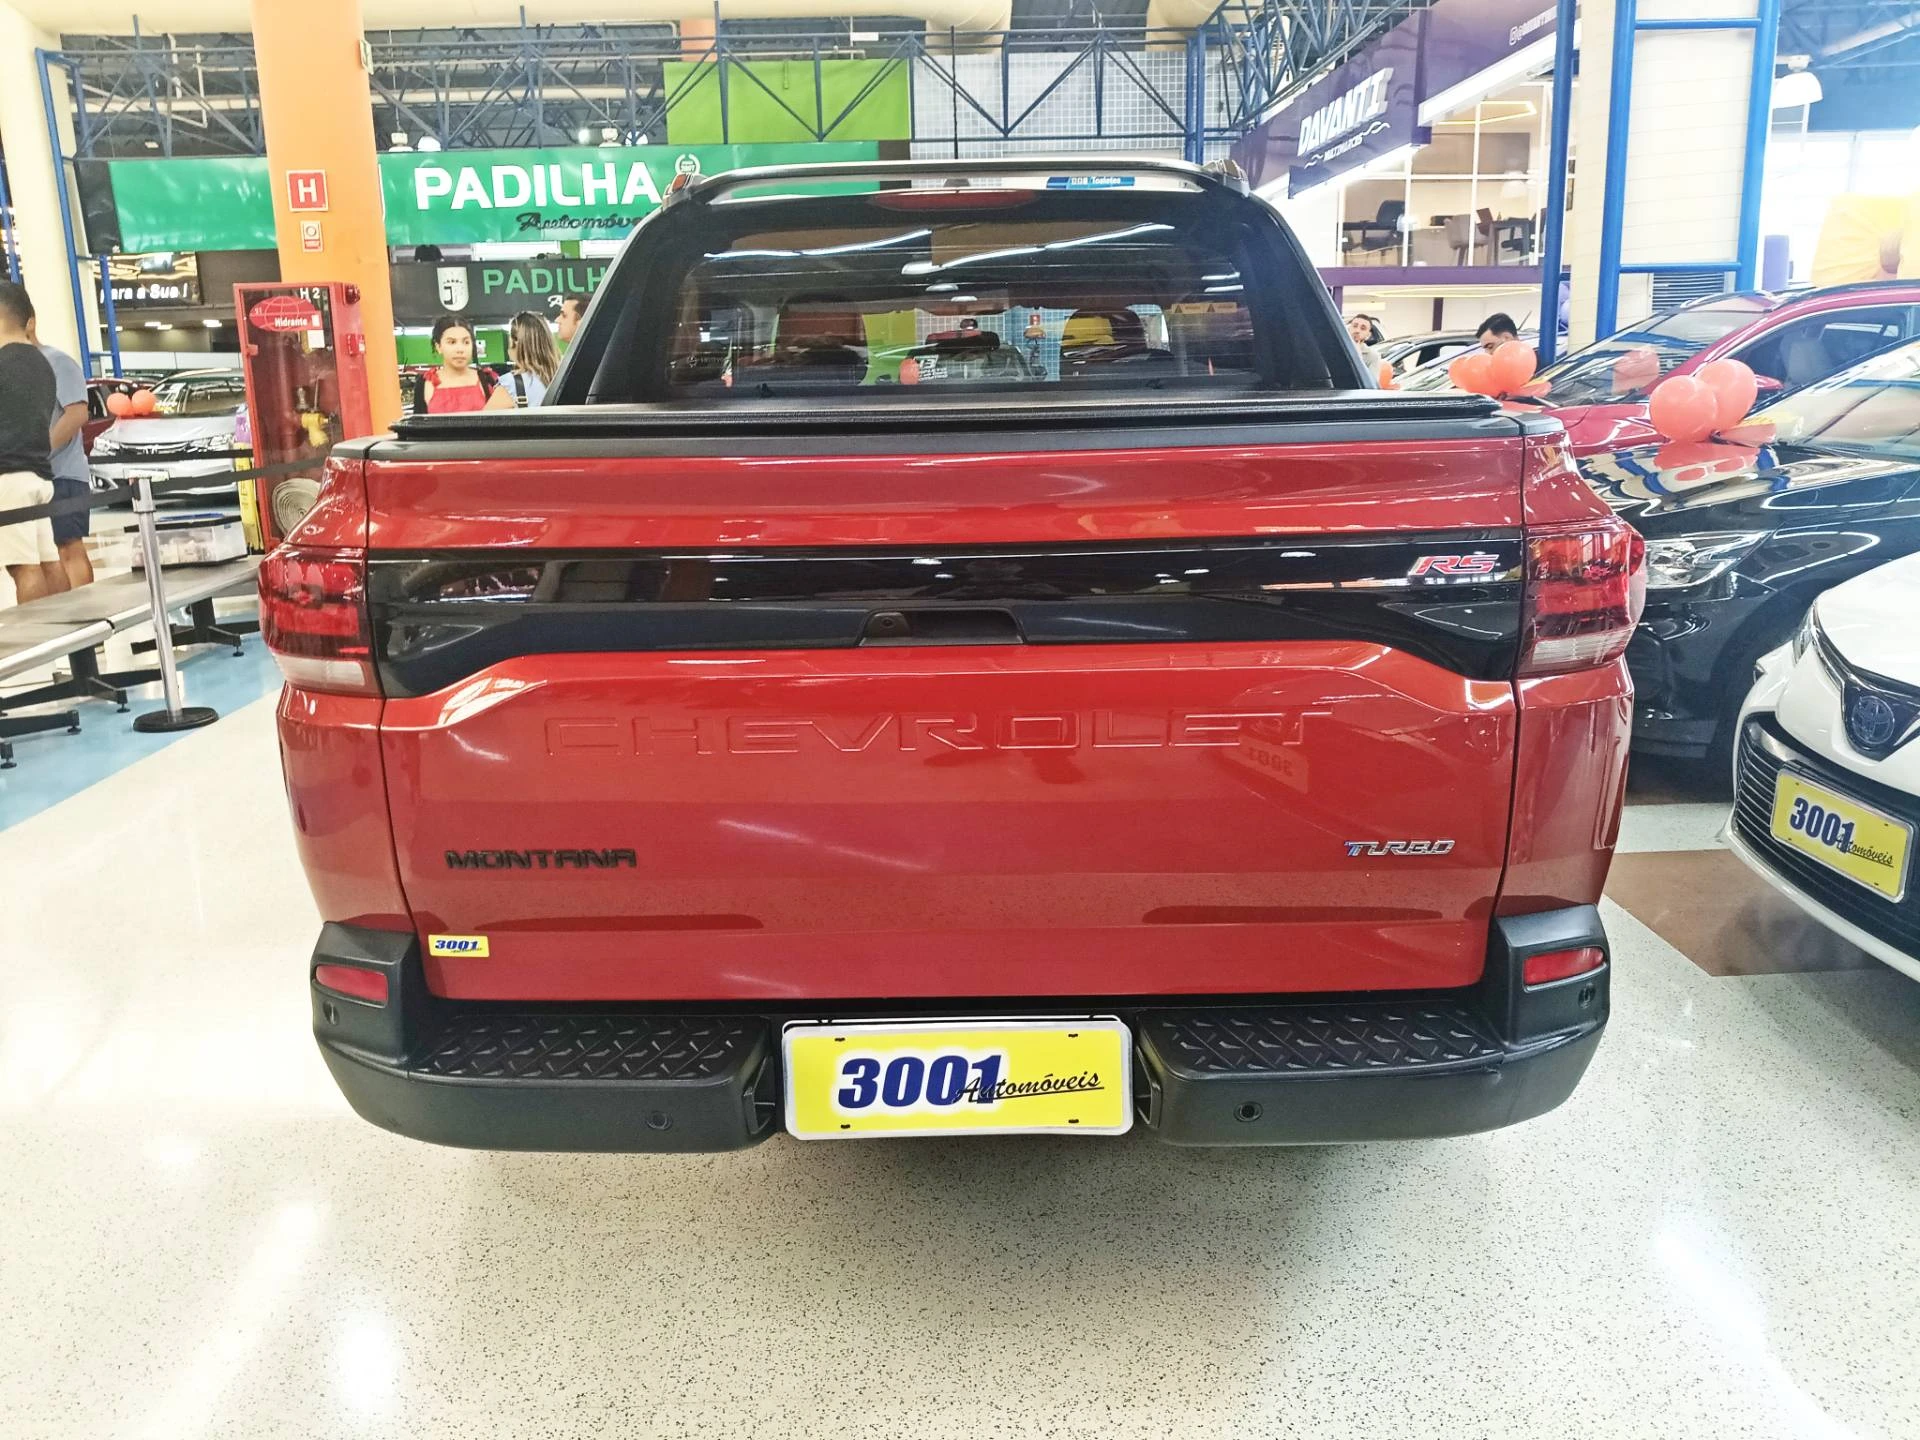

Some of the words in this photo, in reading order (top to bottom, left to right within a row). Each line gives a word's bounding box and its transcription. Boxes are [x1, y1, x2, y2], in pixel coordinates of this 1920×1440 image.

[1297, 67, 1393, 157] DAVANTI
[297, 178, 318, 203] H
[414, 160, 663, 210] PADILHA
[516, 211, 650, 232] Automóve
[482, 266, 608, 294] PADILH
[300, 287, 310, 300] H
[312, 287, 321, 299] 2
[274, 317, 308, 327] Hidrante
[1407, 554, 1499, 575] RS
[545, 707, 1334, 755] CHEVROLET
[1790, 797, 1855, 854] 3001
[445, 848, 637, 869] MONTANA
[1344, 839, 1456, 856] TURBO
[435, 939, 478, 950] 3001
[838, 1054, 1002, 1109] 3001
[953, 1070, 1104, 1102] Automóveis
